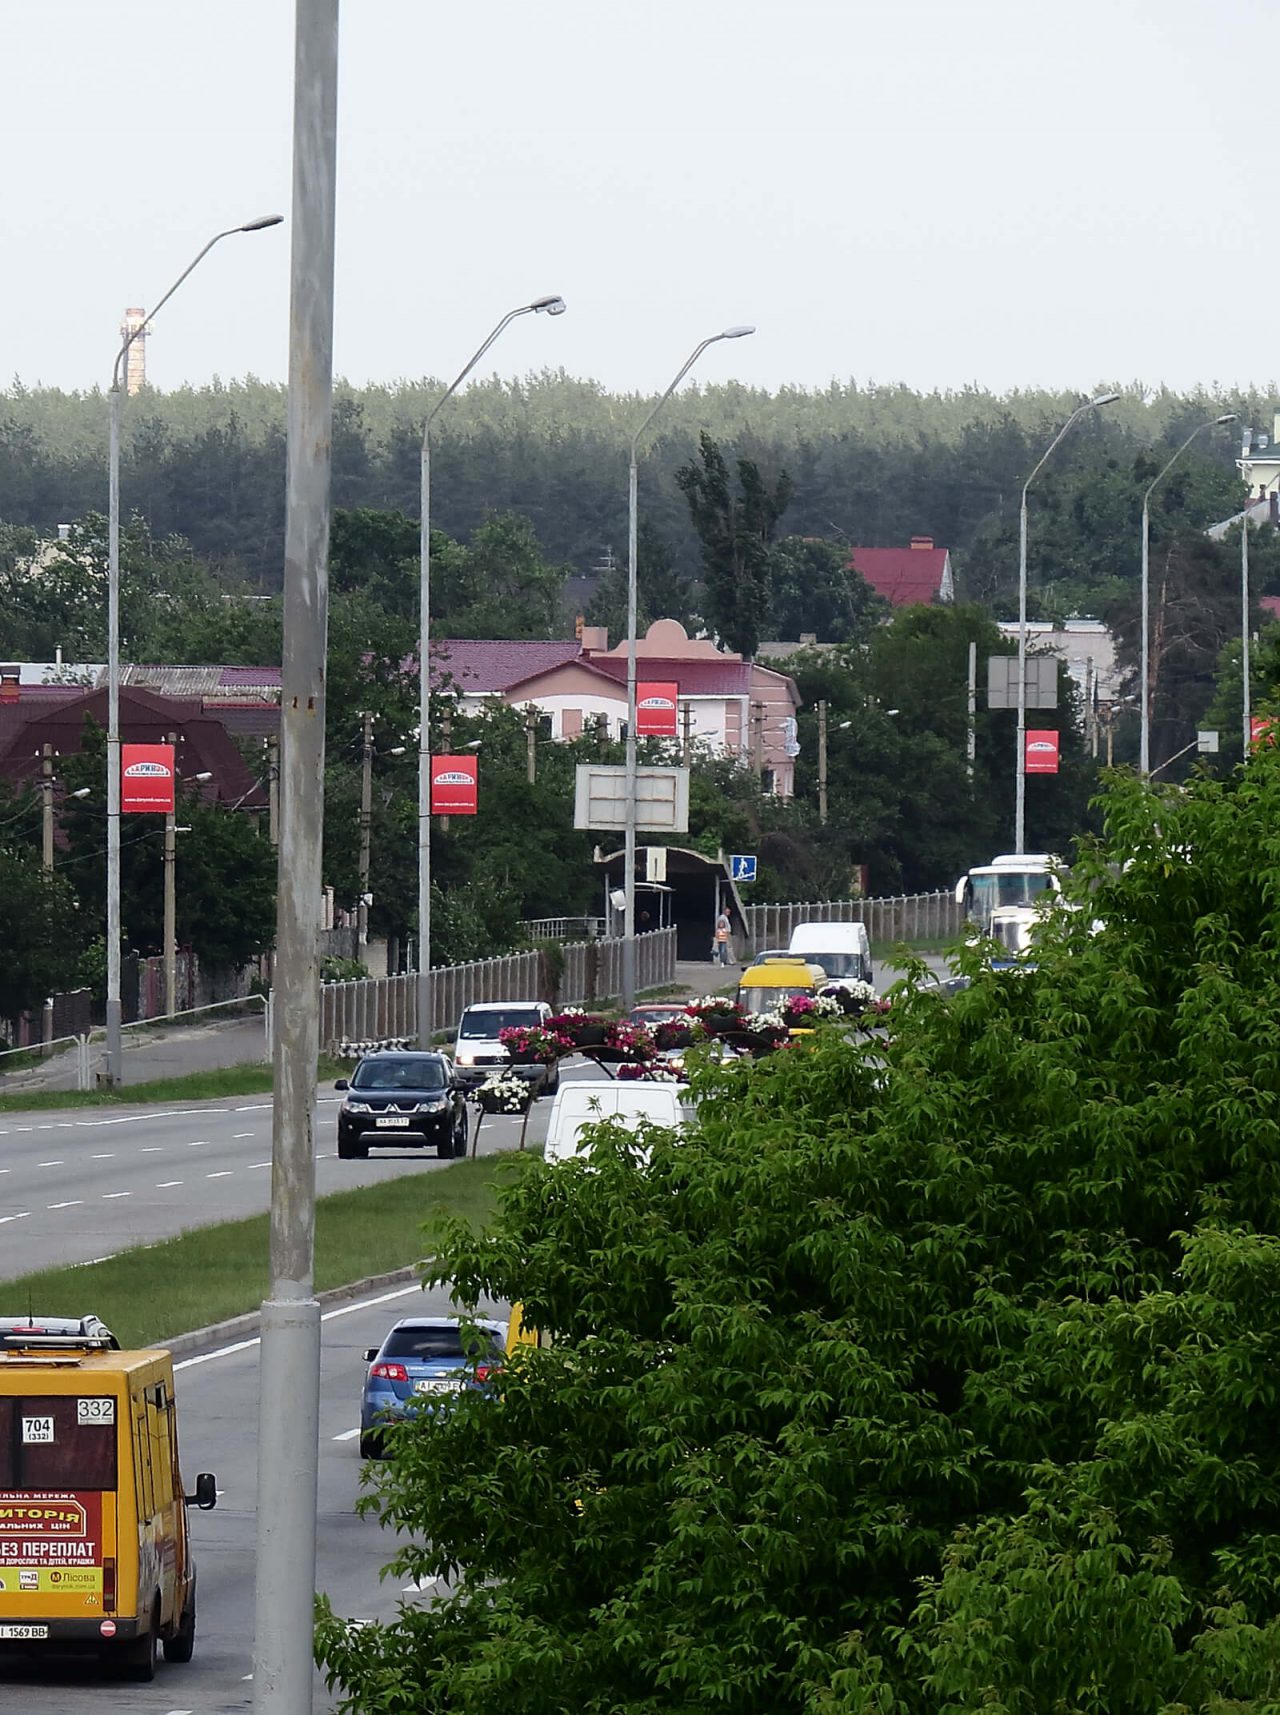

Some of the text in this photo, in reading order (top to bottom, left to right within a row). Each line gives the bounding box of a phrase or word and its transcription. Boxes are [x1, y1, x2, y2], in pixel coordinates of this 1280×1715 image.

[79, 1401, 112, 1417] 332
[25, 1419, 51, 1432] 704
[22, 1542, 95, 1557] ПЕРЕПЛАТ
[63, 1573, 96, 1582] Лісова
[9, 1627, 29, 1637] 1569
[31, 1627, 45, 1637] BB
